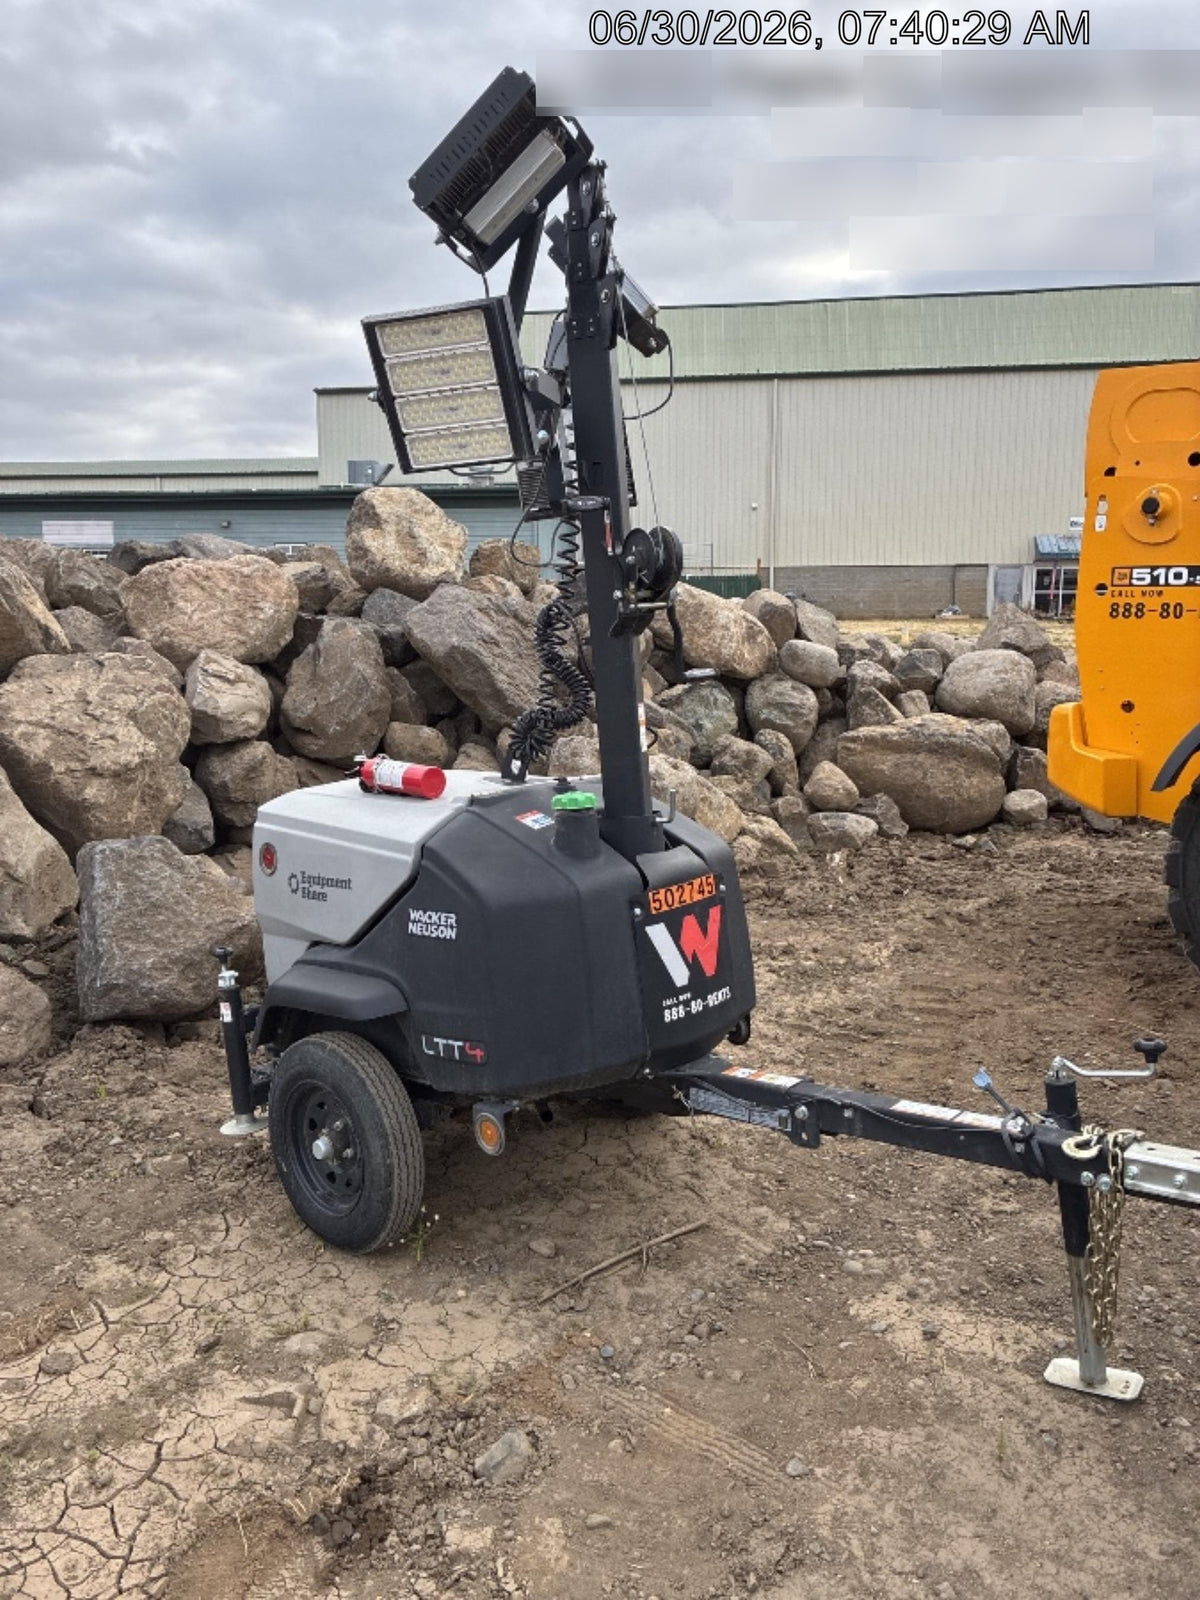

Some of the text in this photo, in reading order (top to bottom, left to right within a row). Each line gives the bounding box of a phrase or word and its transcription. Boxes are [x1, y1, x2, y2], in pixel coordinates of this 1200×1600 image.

[1111, 590, 1136, 598] CALL
[1109, 602, 1200, 619] 888-80-
[300, 871, 352, 889] Equipment
[301, 887, 327, 901] Share
[651, 875, 715, 912] 502745
[409, 908, 457, 926] WACKER
[408, 922, 457, 940] NEUSON
[421, 1035, 484, 1063] LTT4
